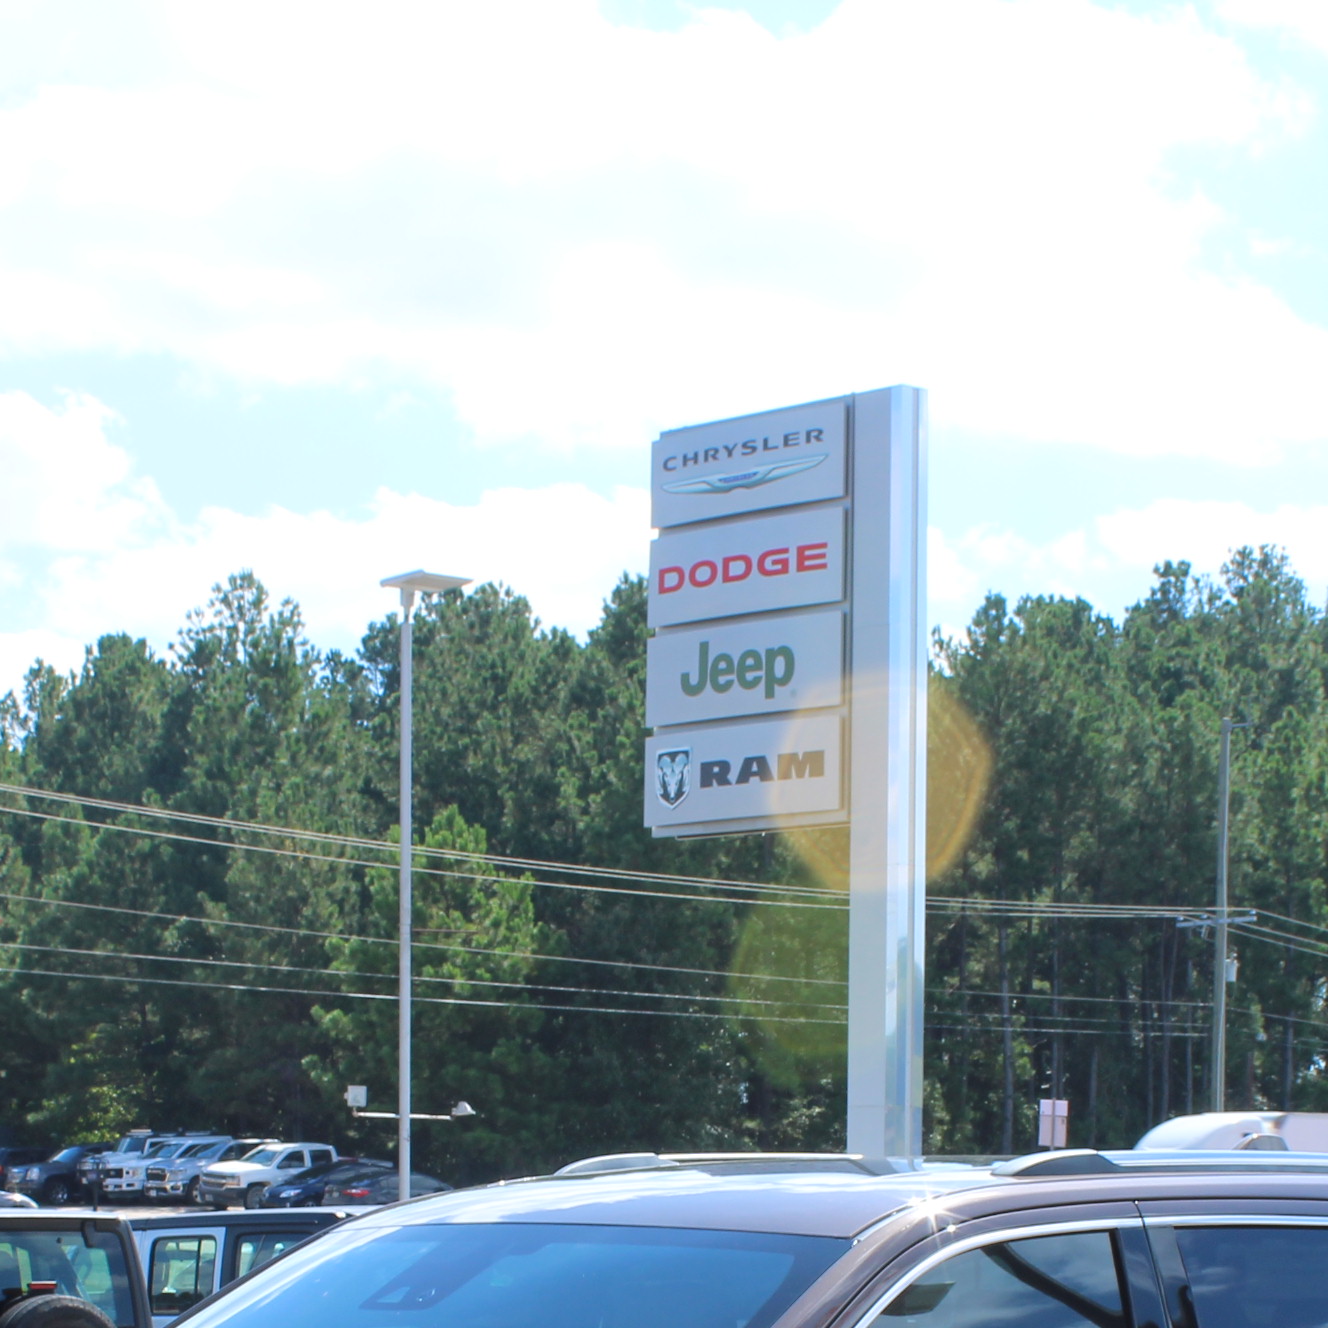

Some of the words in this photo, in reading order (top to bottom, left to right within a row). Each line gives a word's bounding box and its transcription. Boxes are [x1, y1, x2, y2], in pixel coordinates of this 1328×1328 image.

[661, 427, 825, 472] CHRYSLER
[657, 542, 829, 595] DODGE
[680, 641, 795, 699] Jeep
[699, 749, 826, 789] RAM
